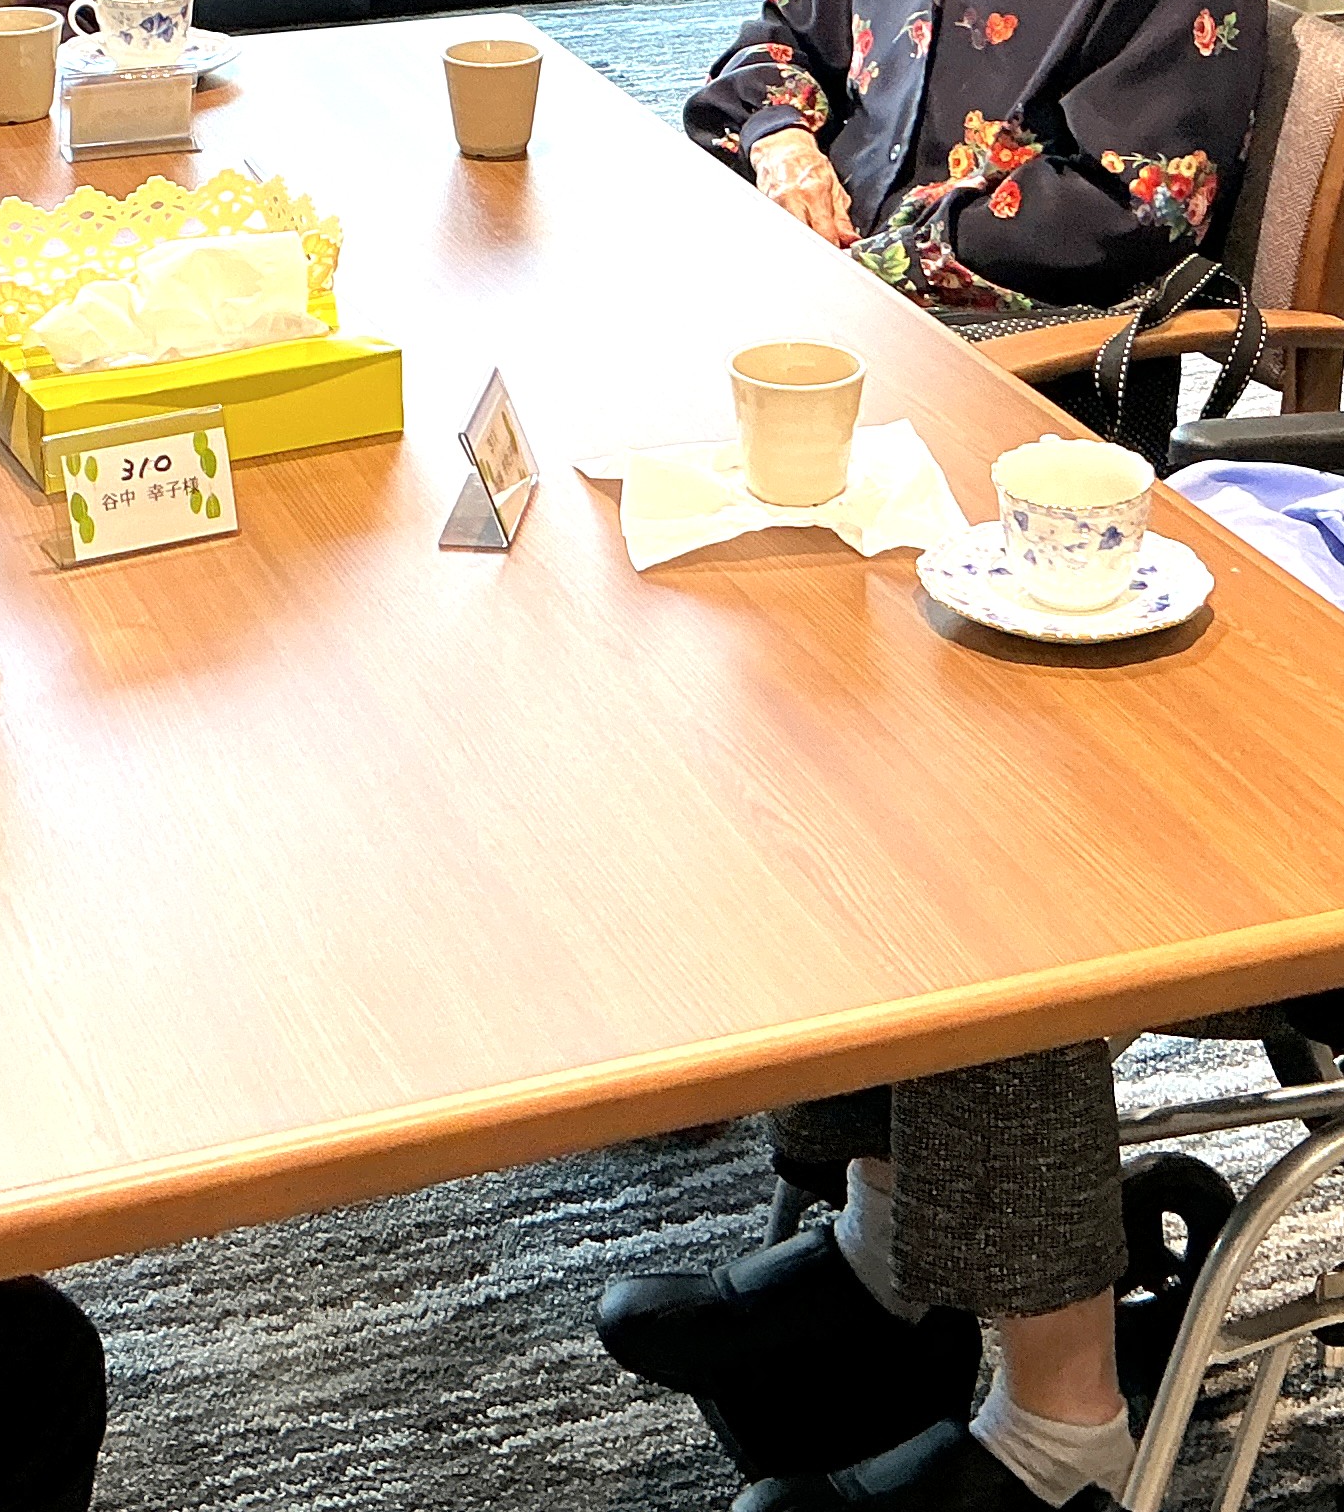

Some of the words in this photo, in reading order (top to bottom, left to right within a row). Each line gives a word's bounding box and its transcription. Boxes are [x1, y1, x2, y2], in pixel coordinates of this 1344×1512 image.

[121, 454, 172, 481] 310
[102, 488, 136, 511] 谷中
[147, 476, 200, 501] 幸子様
